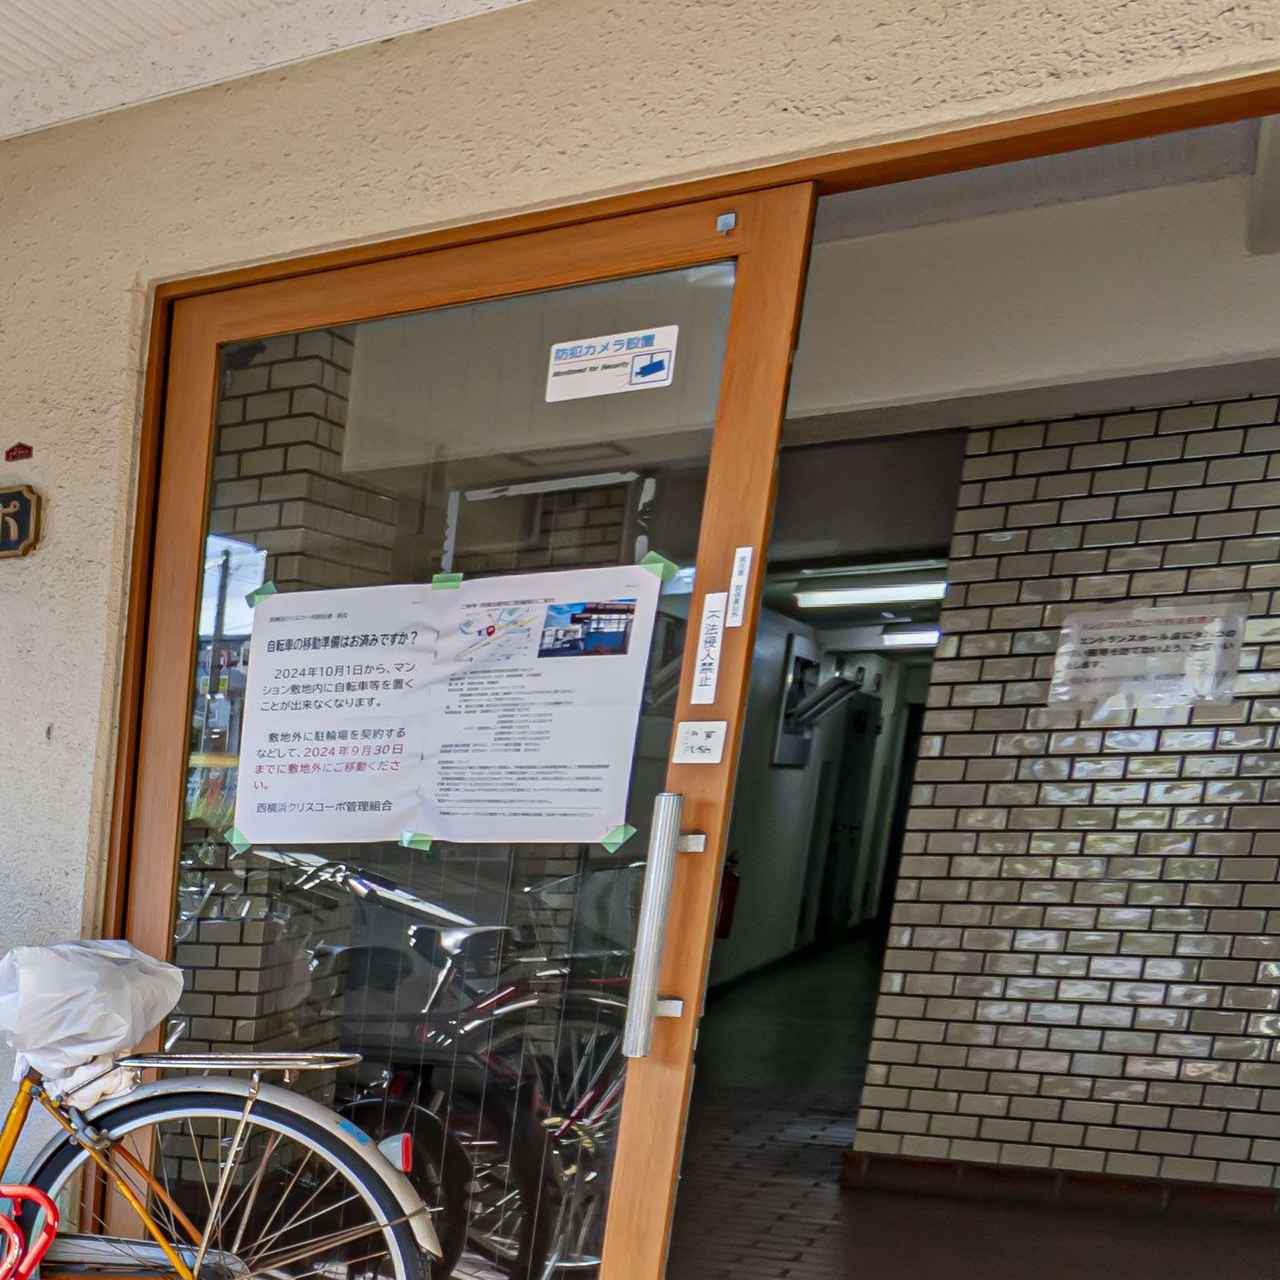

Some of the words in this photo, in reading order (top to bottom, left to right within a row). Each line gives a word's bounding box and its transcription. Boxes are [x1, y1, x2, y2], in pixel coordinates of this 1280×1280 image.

[555, 334, 655, 361] 防犯カメラ設置
[262, 678, 415, 696] ション敷地内に自転車等を置く
[260, 697, 381, 712] ことが出来なくなります。
